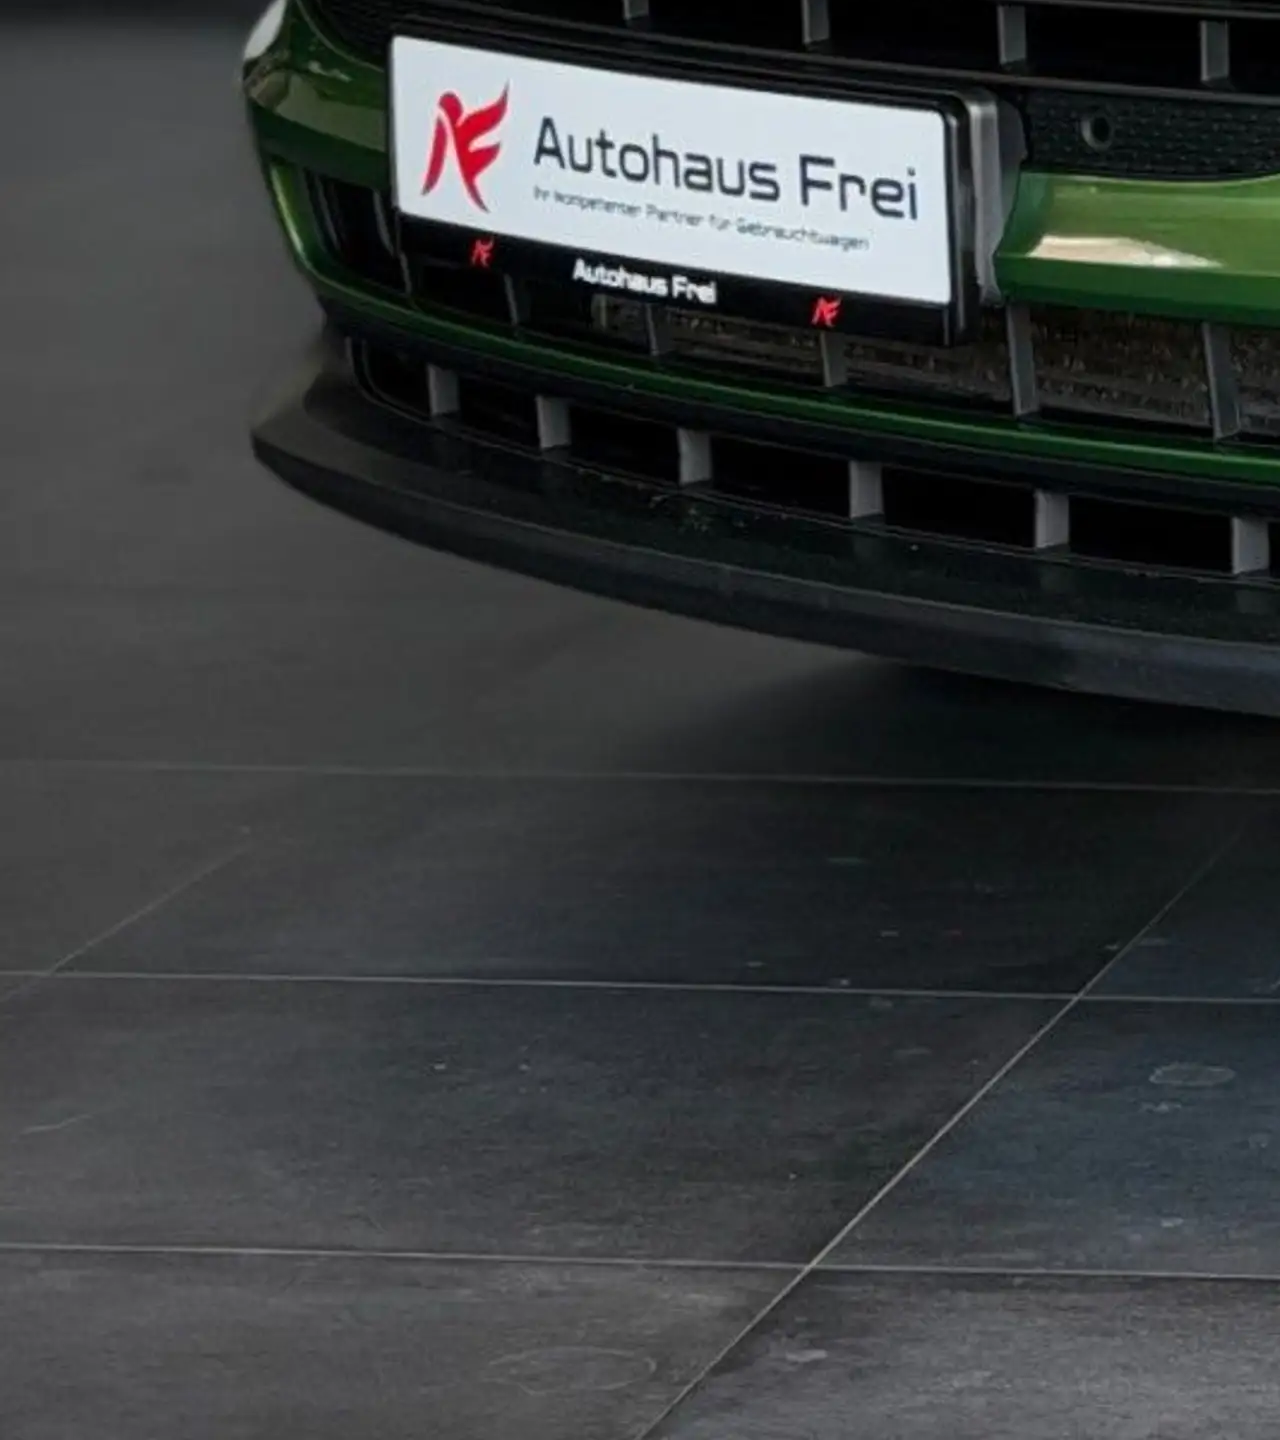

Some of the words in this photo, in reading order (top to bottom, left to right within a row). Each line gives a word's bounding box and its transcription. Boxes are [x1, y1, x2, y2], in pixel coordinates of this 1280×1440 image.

[533, 116, 781, 202] Autohaus
[798, 154, 918, 220] Frei
[572, 258, 669, 297] Autohaus
[671, 274, 717, 314] Frei
